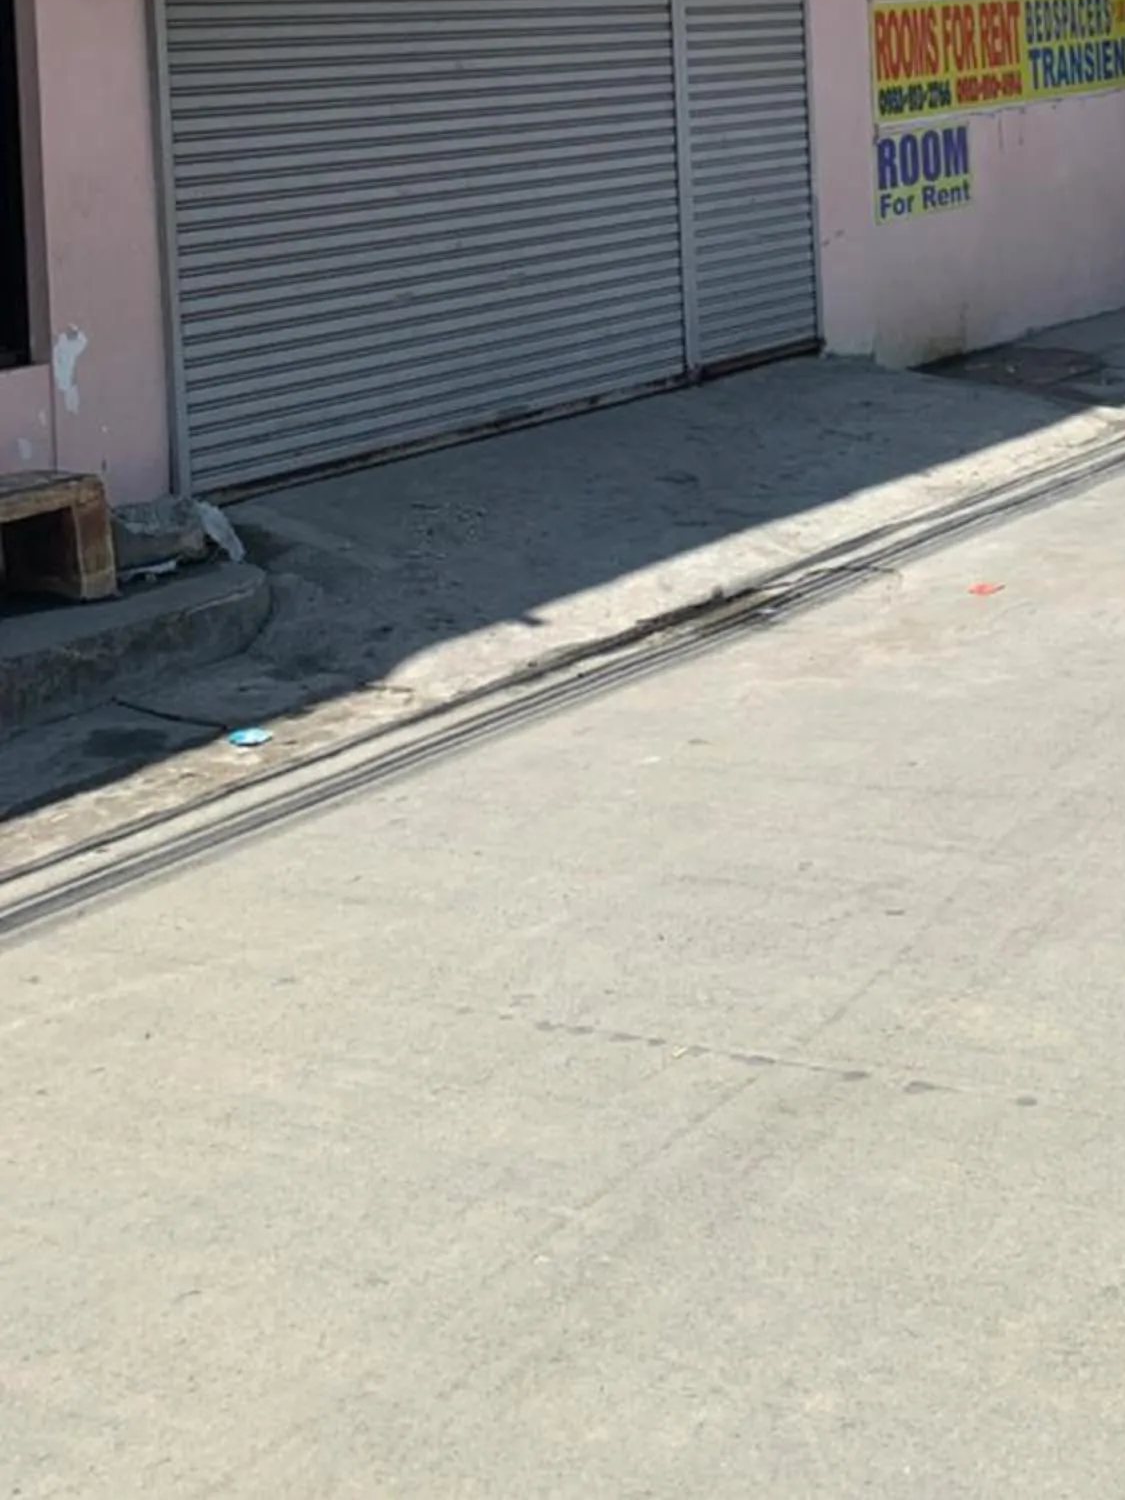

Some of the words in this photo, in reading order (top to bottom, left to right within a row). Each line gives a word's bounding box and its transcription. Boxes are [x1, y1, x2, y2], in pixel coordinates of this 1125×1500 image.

[874, 6, 940, 83] ROOMS
[941, 3, 978, 72] FOR
[979, 0, 1021, 69] RENT
[877, 126, 969, 192] ROOM
[880, 193, 915, 219] For
[921, 180, 971, 211] Rent
